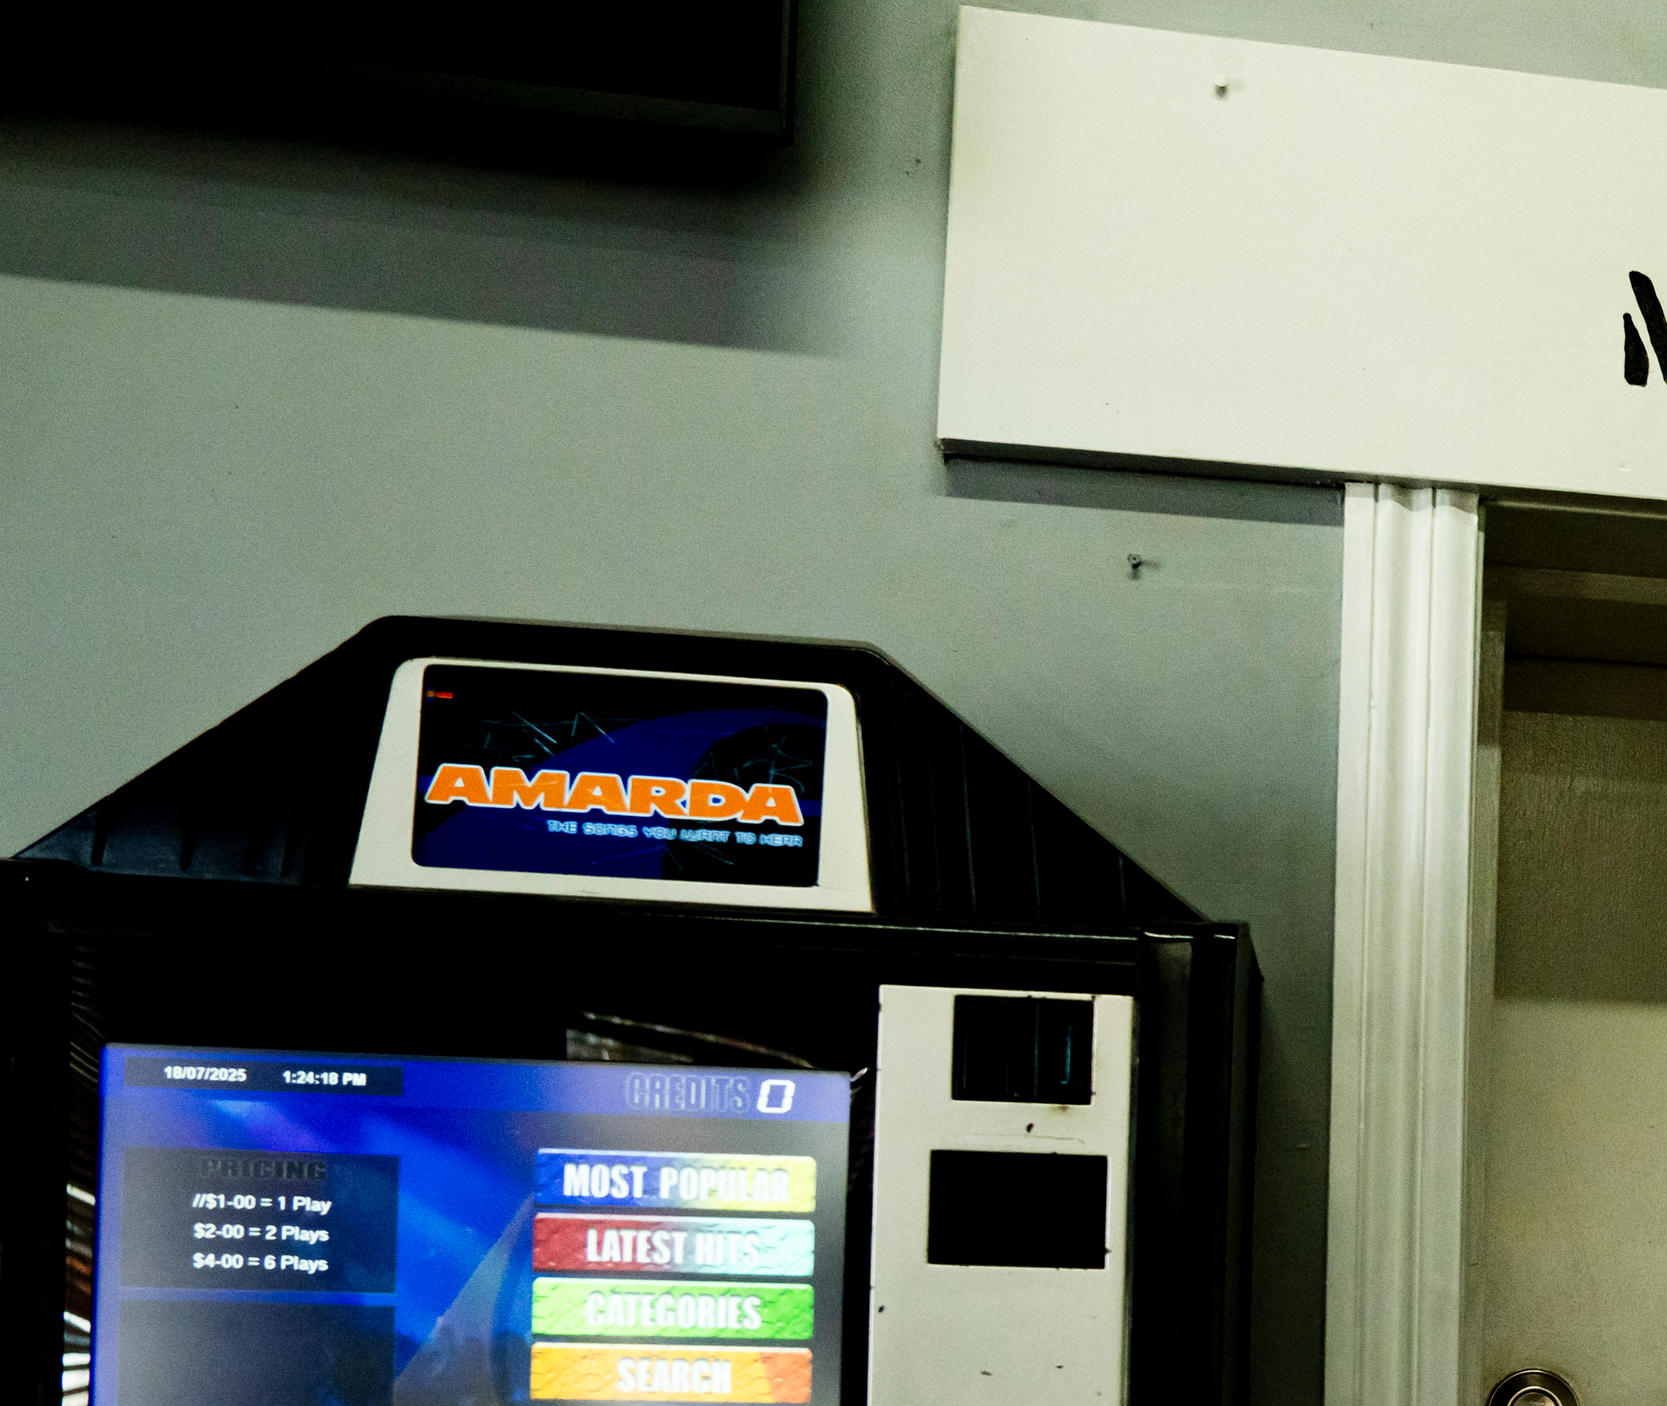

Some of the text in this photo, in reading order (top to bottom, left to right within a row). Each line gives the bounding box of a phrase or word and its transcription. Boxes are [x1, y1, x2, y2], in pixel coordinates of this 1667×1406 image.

[425, 763, 803, 825] AMARDA
[164, 1066, 367, 1086] 18/07/2025 1:24:18 PM
[626, 1072, 750, 1113] CREDITS
[563, 1163, 789, 1201] MOST POPULAR
[294, 1196, 332, 1215] Play
[193, 1223, 329, 1244] $2-00 2 Plays
[587, 1229, 759, 1265] LATEST HITS
[193, 1253, 328, 1274] $4-00 6 Plays
[586, 1292, 762, 1329] CATEGORIES
[616, 1357, 732, 1393] SEARCH
